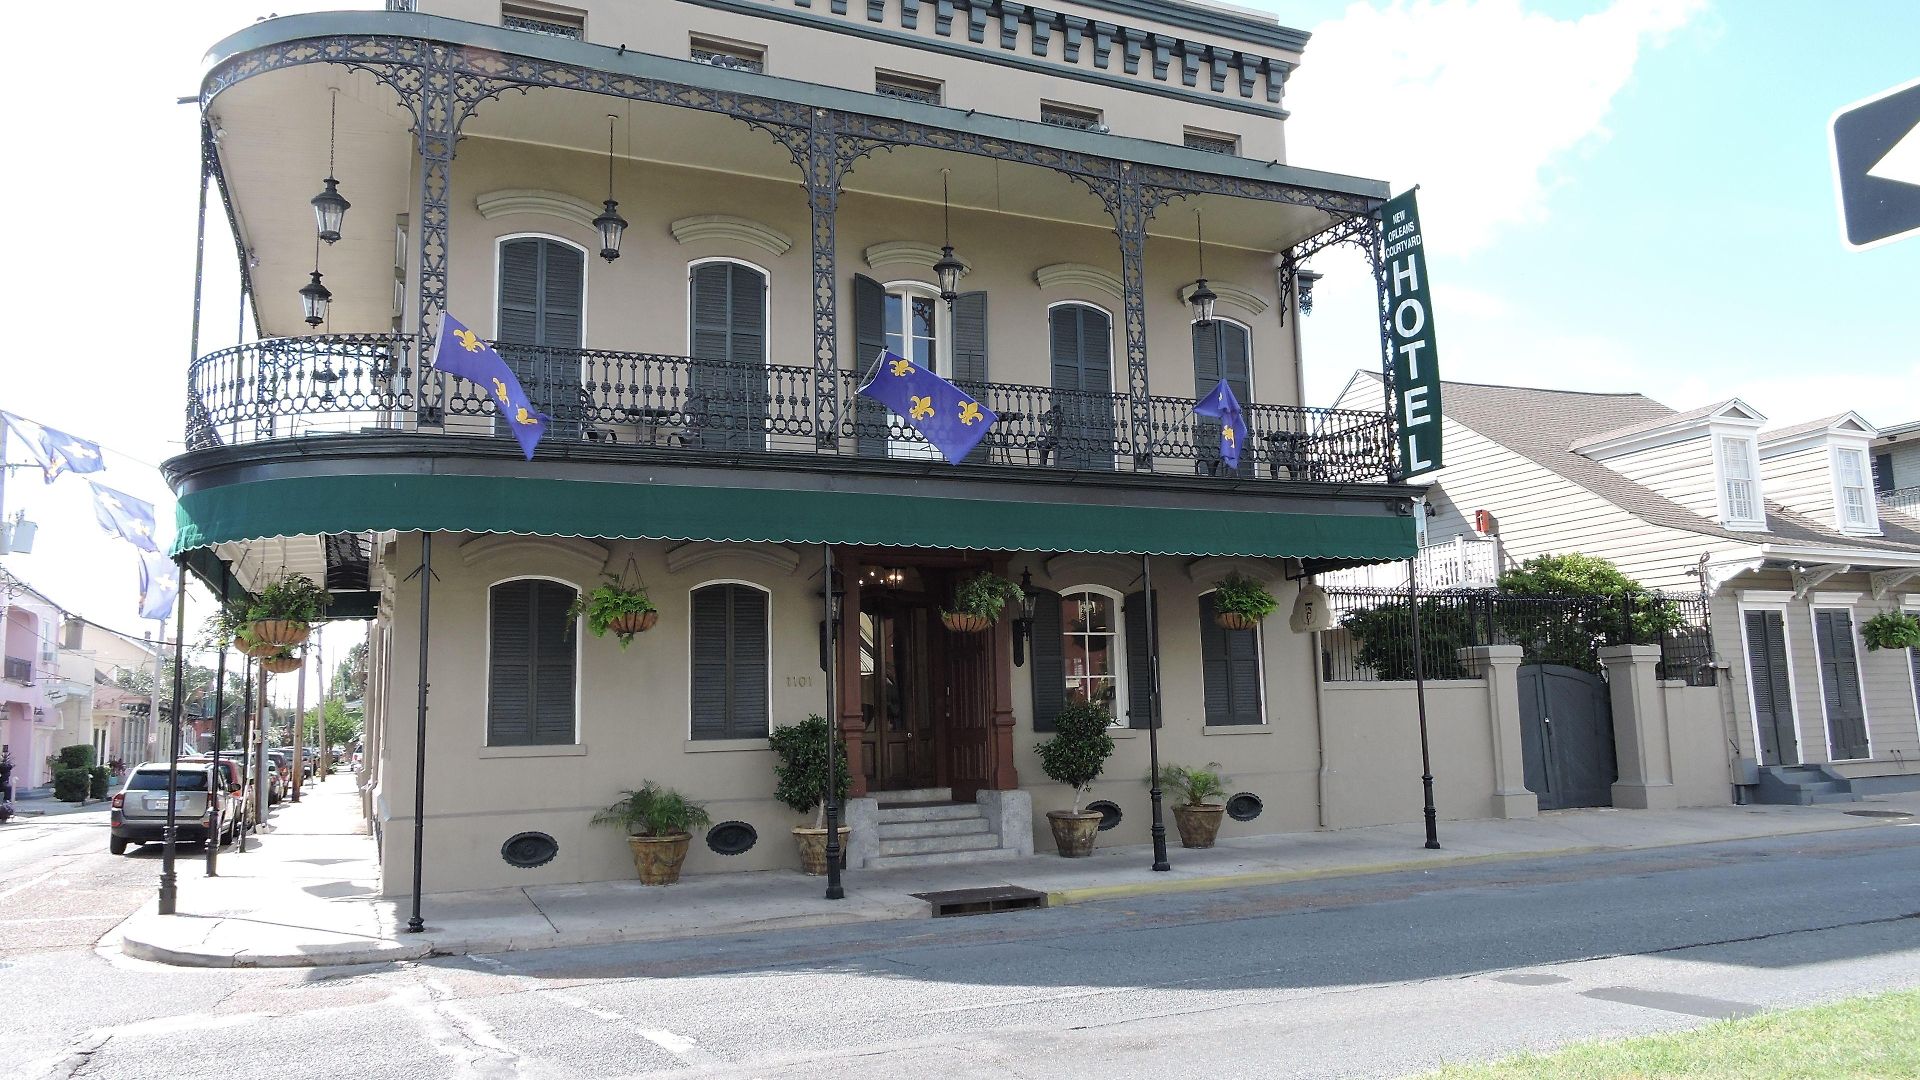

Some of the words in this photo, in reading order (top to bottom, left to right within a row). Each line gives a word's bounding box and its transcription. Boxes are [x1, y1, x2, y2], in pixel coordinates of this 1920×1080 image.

[1392, 210, 1405, 224] NEW
[1388, 221, 1415, 242] ORLEANS
[1385, 235, 1421, 258] COURTYARD
[1392, 254, 1432, 472] HOTEL
[786, 676, 812, 687] 1101
